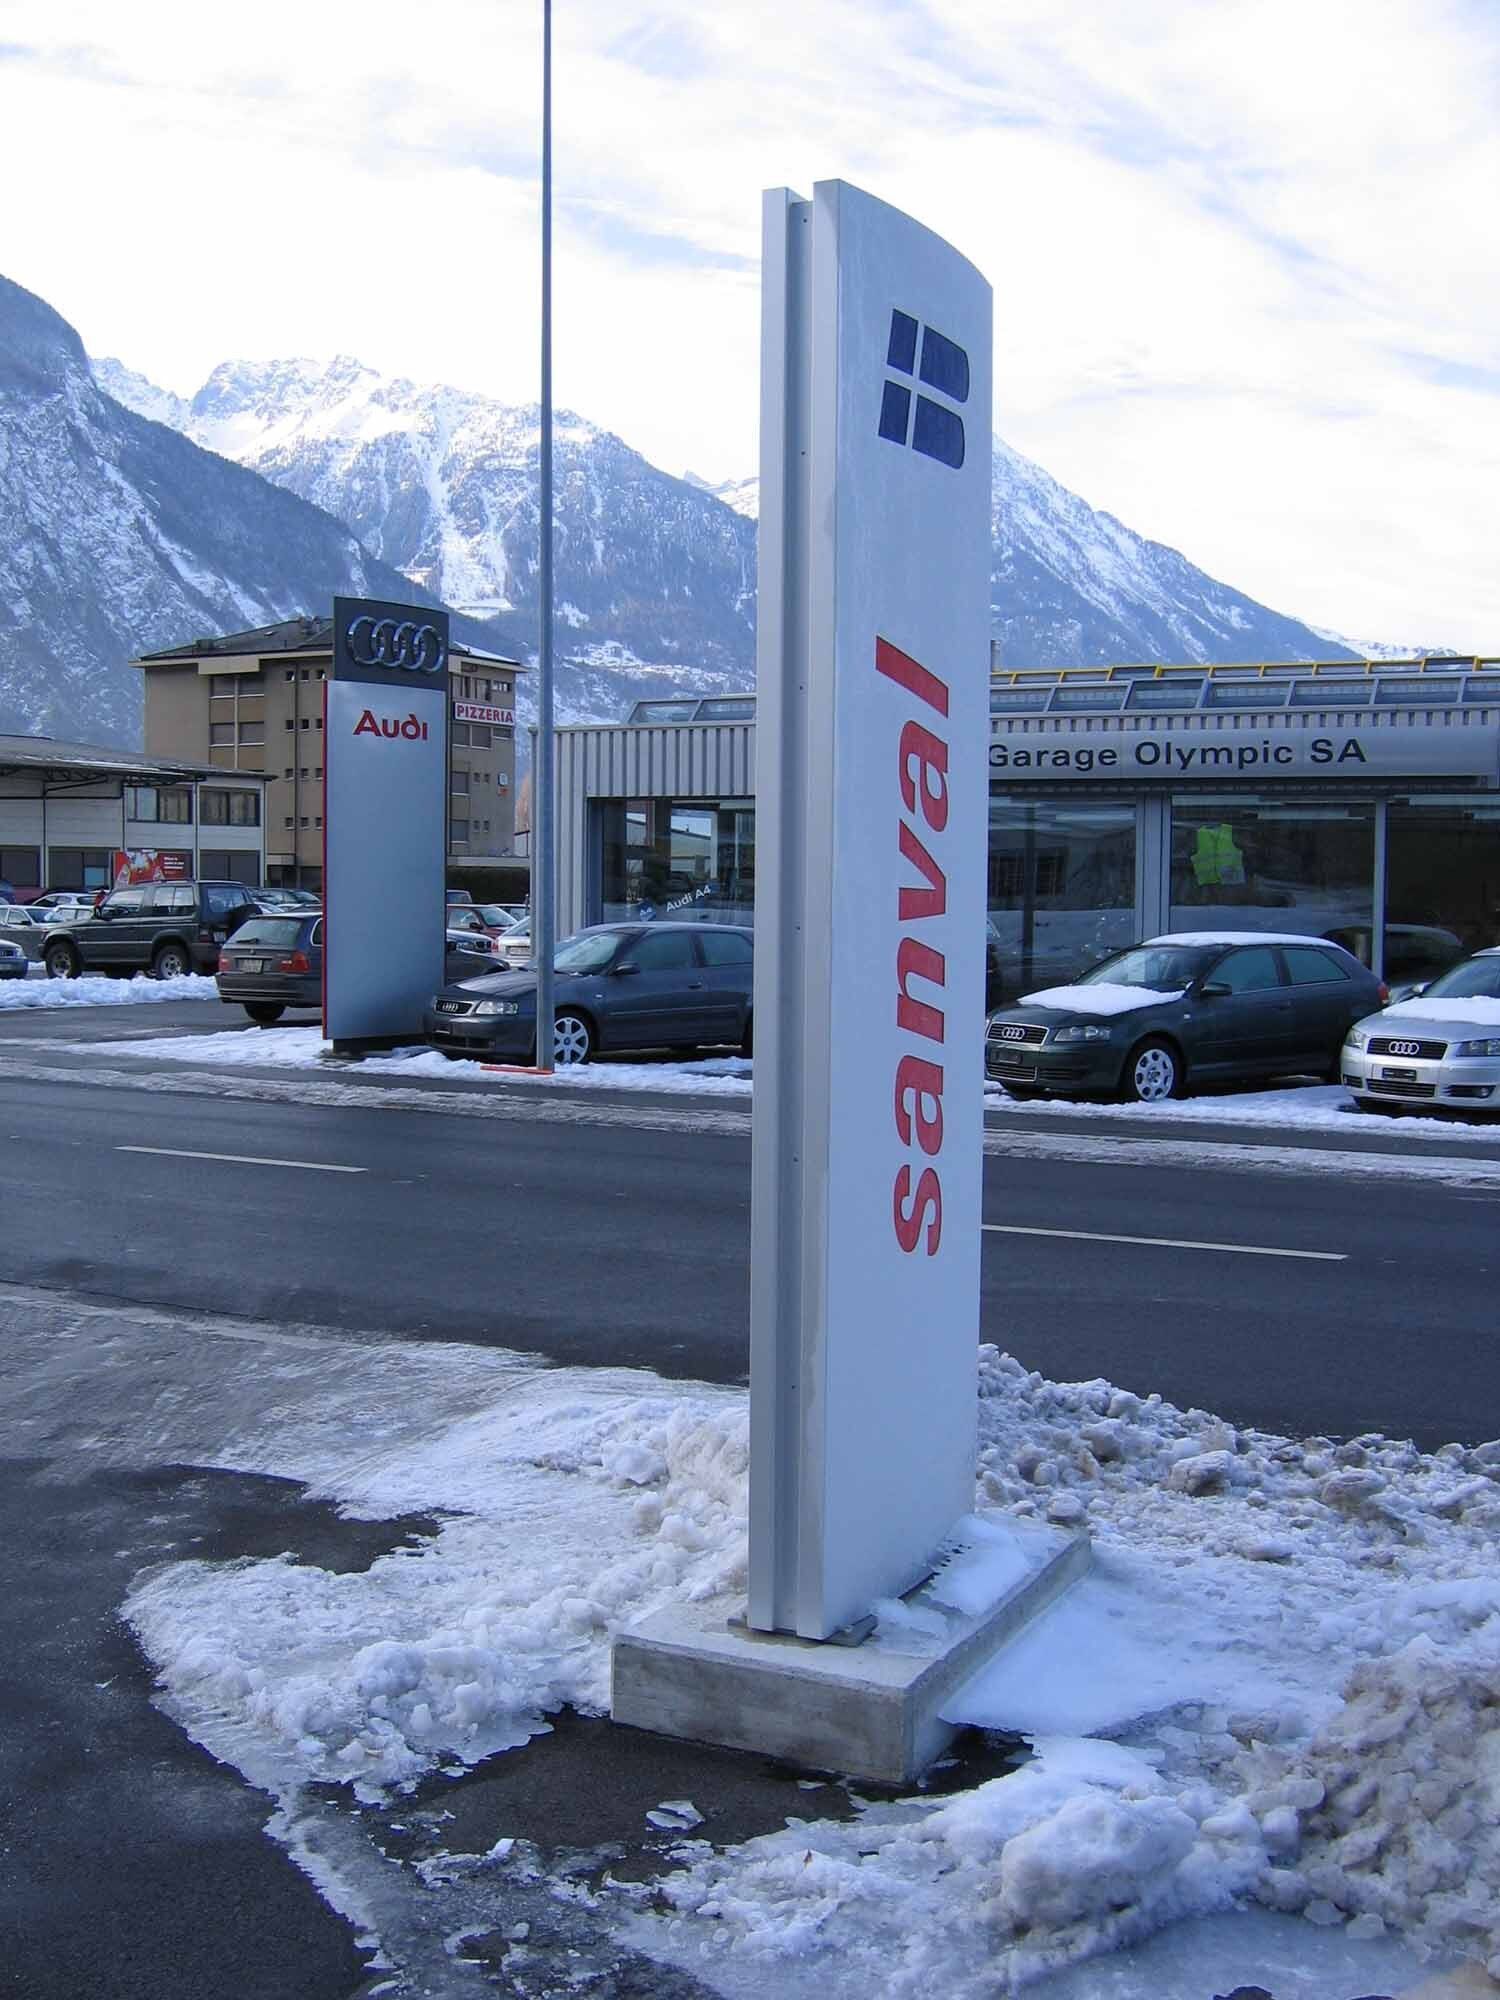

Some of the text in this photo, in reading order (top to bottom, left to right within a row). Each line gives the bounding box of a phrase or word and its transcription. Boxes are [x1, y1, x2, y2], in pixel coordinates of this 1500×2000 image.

[352, 709, 428, 741] Audi
[457, 705, 514, 723] PIZZERIA
[988, 738, 1368, 771] Garage Olympic SA
[666, 892, 693, 912] Audi
[695, 884, 712, 899] A4
[875, 635, 949, 1256] sanval
